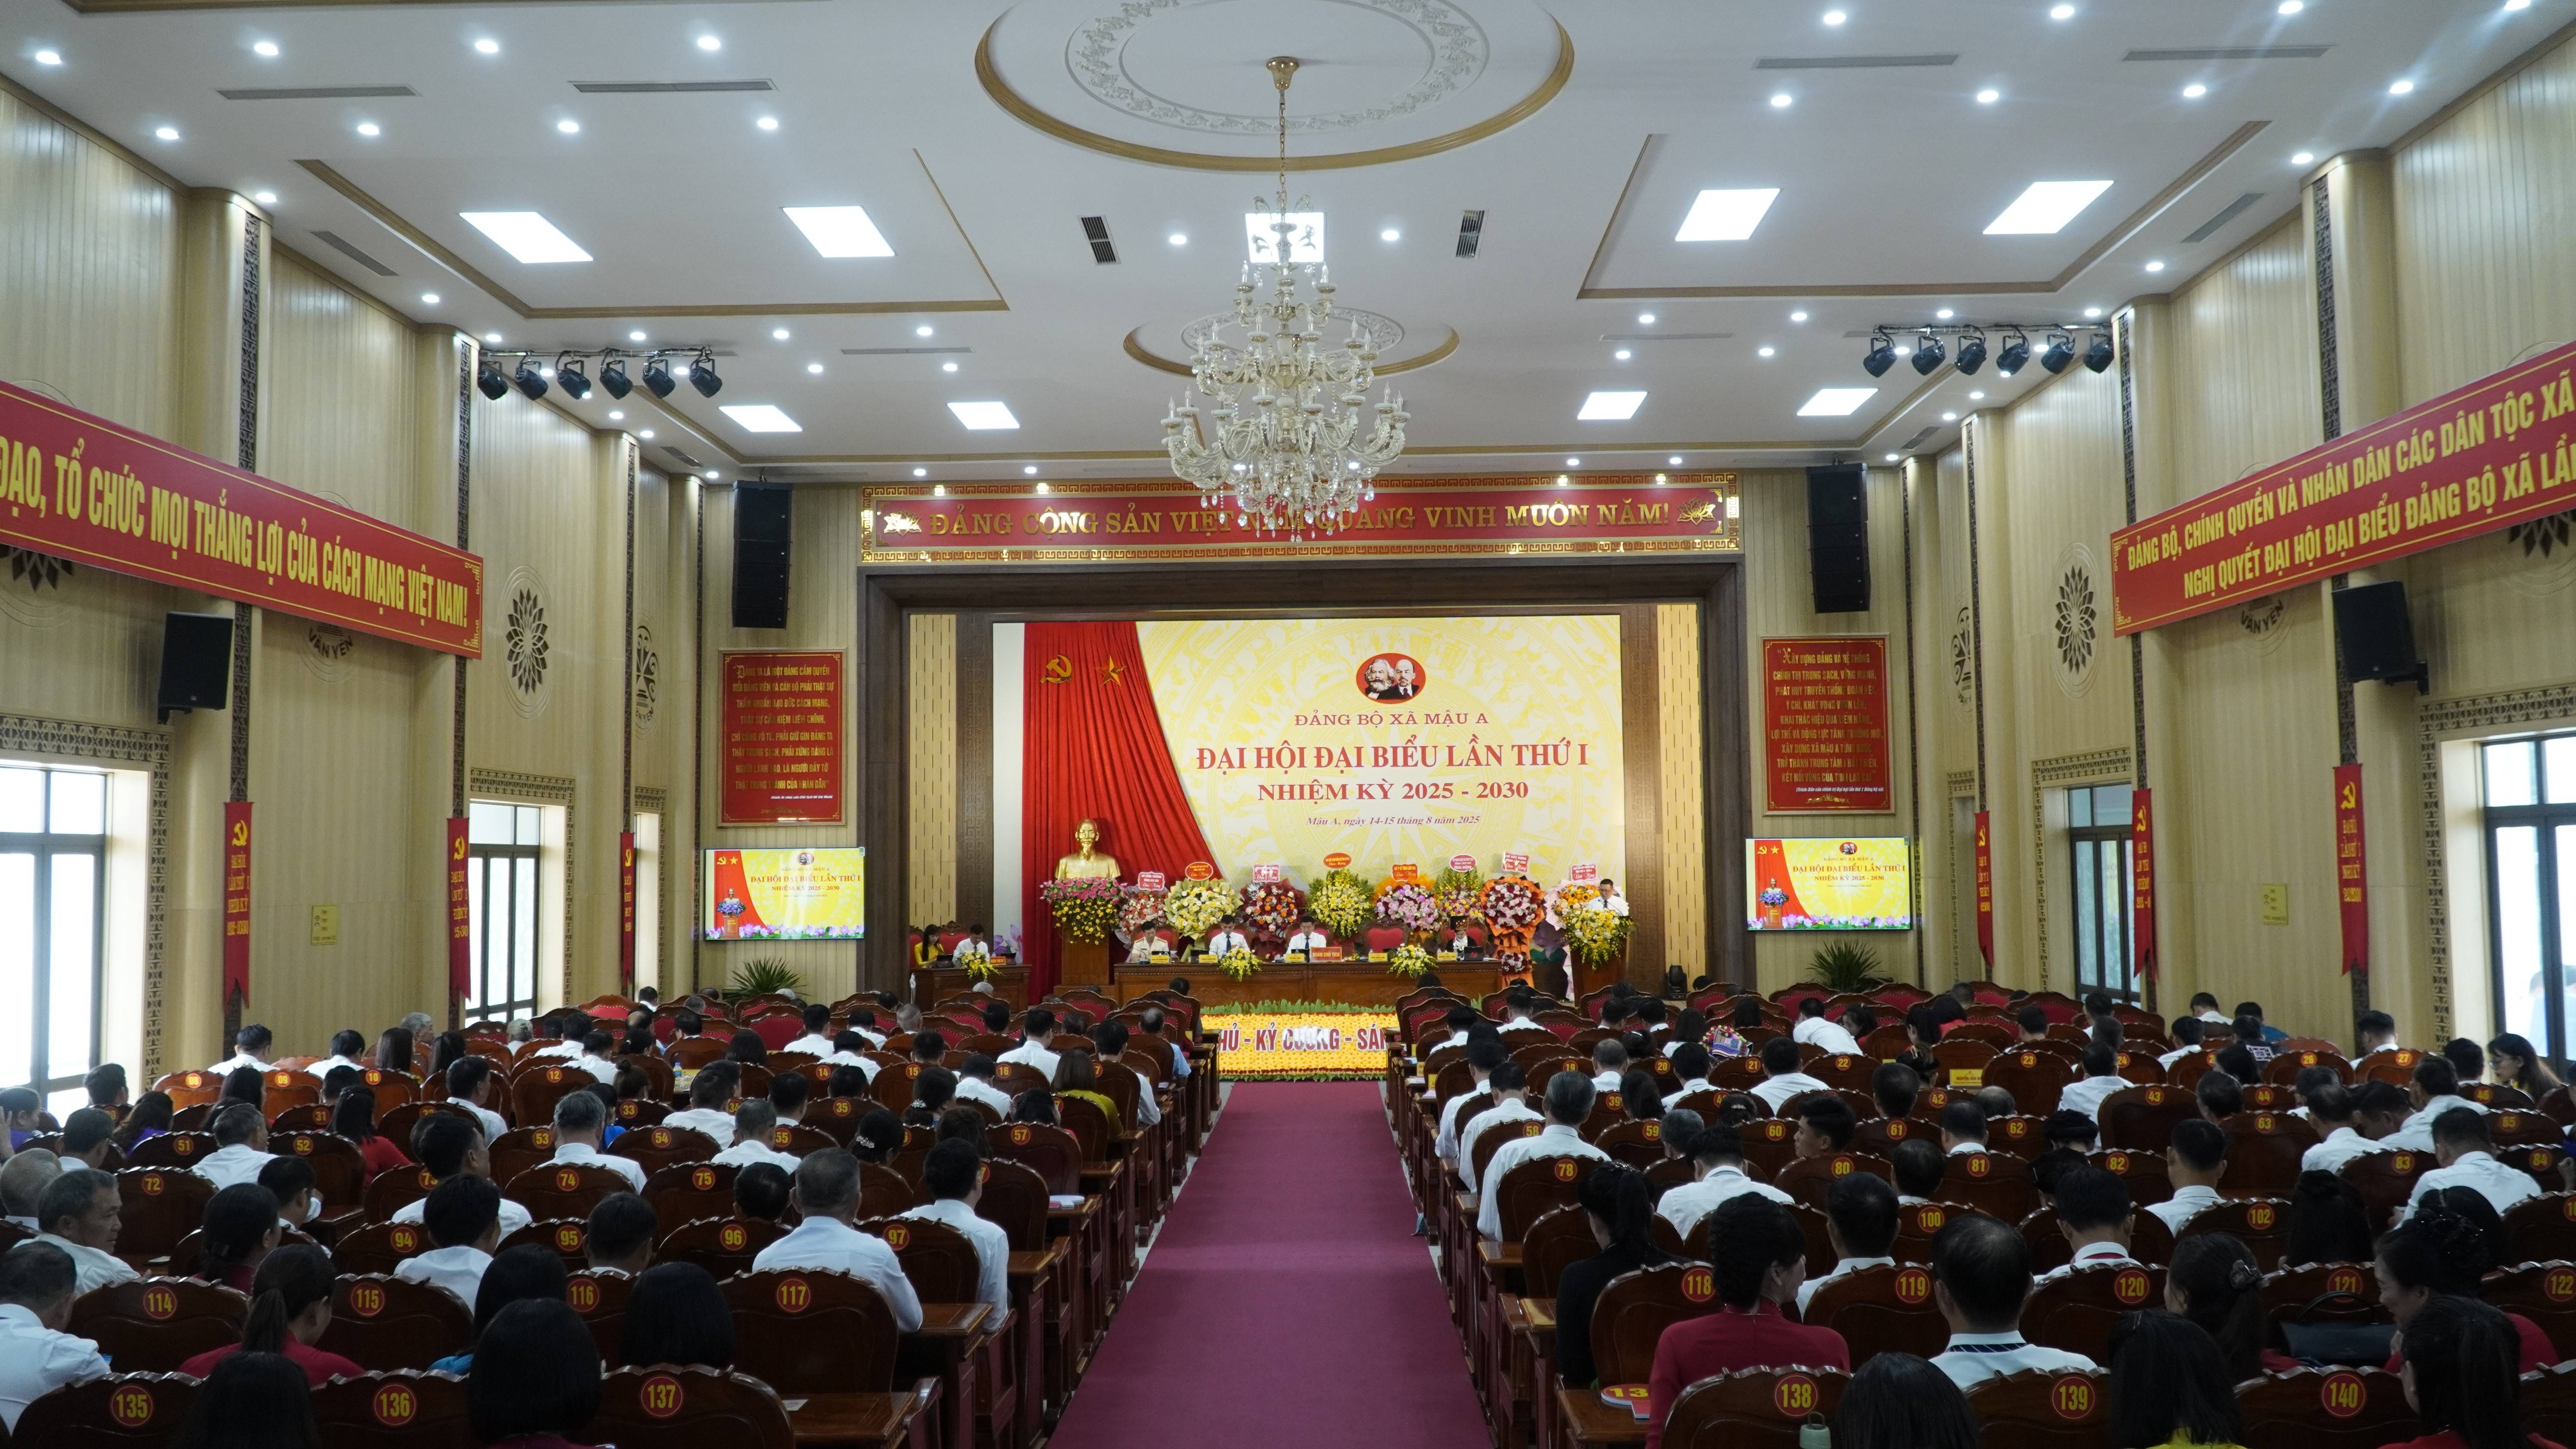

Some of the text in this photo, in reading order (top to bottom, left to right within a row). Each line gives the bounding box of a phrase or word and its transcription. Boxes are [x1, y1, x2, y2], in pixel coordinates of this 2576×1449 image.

[2128, 369, 2576, 571] ĐẢNG BỘ, CHÍNH QUYỀN VÀ NHÂN DÂN CÁC DÂN TỘC XÃ
[930, 504, 1013, 535] ĐẢNG
[1023, 506, 1099, 540] CỘNG
[1106, 503, 1162, 533] SẢN
[1170, 506, 1234, 537] VIỆT
[1315, 506, 1416, 530] QUANG
[1424, 506, 1497, 527] VINH
[1505, 498, 1589, 526] MUÔN
[1597, 498, 1669, 525] NĂM!
[2184, 564, 2215, 597] NGHỊ
[2219, 542, 2260, 590] QUYẾT
[2264, 539, 2290, 576] ĐẠI
[2294, 525, 2321, 567] HỘI
[2325, 517, 2354, 558] ĐẠI
[2359, 493, 2400, 544] BIỂU
[2405, 481, 2461, 530] ĐẢNG
[2467, 464, 2496, 514] BỘ
[2502, 452, 2535, 501] XÃ
[55, 438, 84, 519] TỔ
[89, 464, 145, 537] CHỨC
[151, 486, 188, 560] MỌI
[194, 488, 252, 567] THẮNG
[257, 521, 283, 585] LỢI
[287, 518, 318, 586] CỦA
[322, 536, 361, 598] CÁCH
[365, 555, 404, 614] MẠNG
[408, 564, 434, 626] VIỆT
[437, 579, 468, 627] NAM!
[1803, 671, 1821, 680] TRONG
[1295, 710, 1488, 727] ĐẢNG BỘ XÃ MẬU A
[1197, 734, 1588, 775] ĐẠI HỘI ĐẠI BIỂU LẦN THỨ I
[1258, 779, 1349, 804] NHIỆM
[1357, 778, 1394, 800] KỲ
[1402, 783, 1454, 799] 2025
[1476, 782, 1528, 798] 2030
[1306, 817, 1328, 826] Mậu
[1344, 817, 1367, 826] ngày
[1397, 816, 1424, 826] tháng
[1810, 864, 1824, 873] HỘI
[1844, 863, 1862, 872] BIỂU
[1865, 863, 1881, 872] LẦN
[767, 875, 781, 884] HỘI
[821, 873, 837, 882] LẦN
[1256, 1022, 1277, 1050] KỶ
[1748, 1060, 1758, 1070] 21
[2023, 1055, 2034, 1065] 23
[2398, 1053, 2410, 1064] 27
[818, 1068, 828, 1076] 14
[908, 1067, 919, 1076] 15
[999, 1067, 1009, 1075] 16
[1657, 1061, 1668, 1071] 20
[276, 1075, 288, 1084] 09
[550, 1070, 559, 1080] 12
[1932, 1094, 1944, 1104] 42
[2148, 1091, 2161, 1102] 43
[316, 1111, 326, 1122] 31
[623, 1105, 635, 1115] 33
[1014, 1129, 1027, 1140] 57
[1768, 1125, 1783, 1137] 60
[2010, 1122, 2023, 1134] 62
[535, 1133, 550, 1145] 53
[655, 1133, 668, 1144] 54
[776, 1131, 789, 1143] 55
[178, 1140, 191, 1151] 51
[1559, 1164, 1574, 1176] 78
[1971, 1159, 1985, 1172] 81
[2110, 1157, 2126, 1170] 82
[146, 1178, 160, 1191] 72
[560, 1173, 576, 1186] 74
[696, 1172, 712, 1185] 75
[1921, 1211, 1941, 1227] 100
[2251, 1209, 2271, 1224] 102
[560, 1230, 578, 1246] 95
[888, 1229, 906, 1244] 97
[1900, 1277, 1926, 1296] 119
[2120, 1277, 2145, 1297] 120
[357, 1289, 379, 1309] 115
[571, 1285, 594, 1305] 116
[781, 1285, 807, 1305] 117
[648, 1385, 676, 1408] 137
[1781, 1384, 1812, 1408] 138
[2060, 1385, 2088, 1410] 139
[2330, 1383, 2358, 1407] 140
[116, 1394, 147, 1418] 135
[381, 1393, 410, 1416] 136
